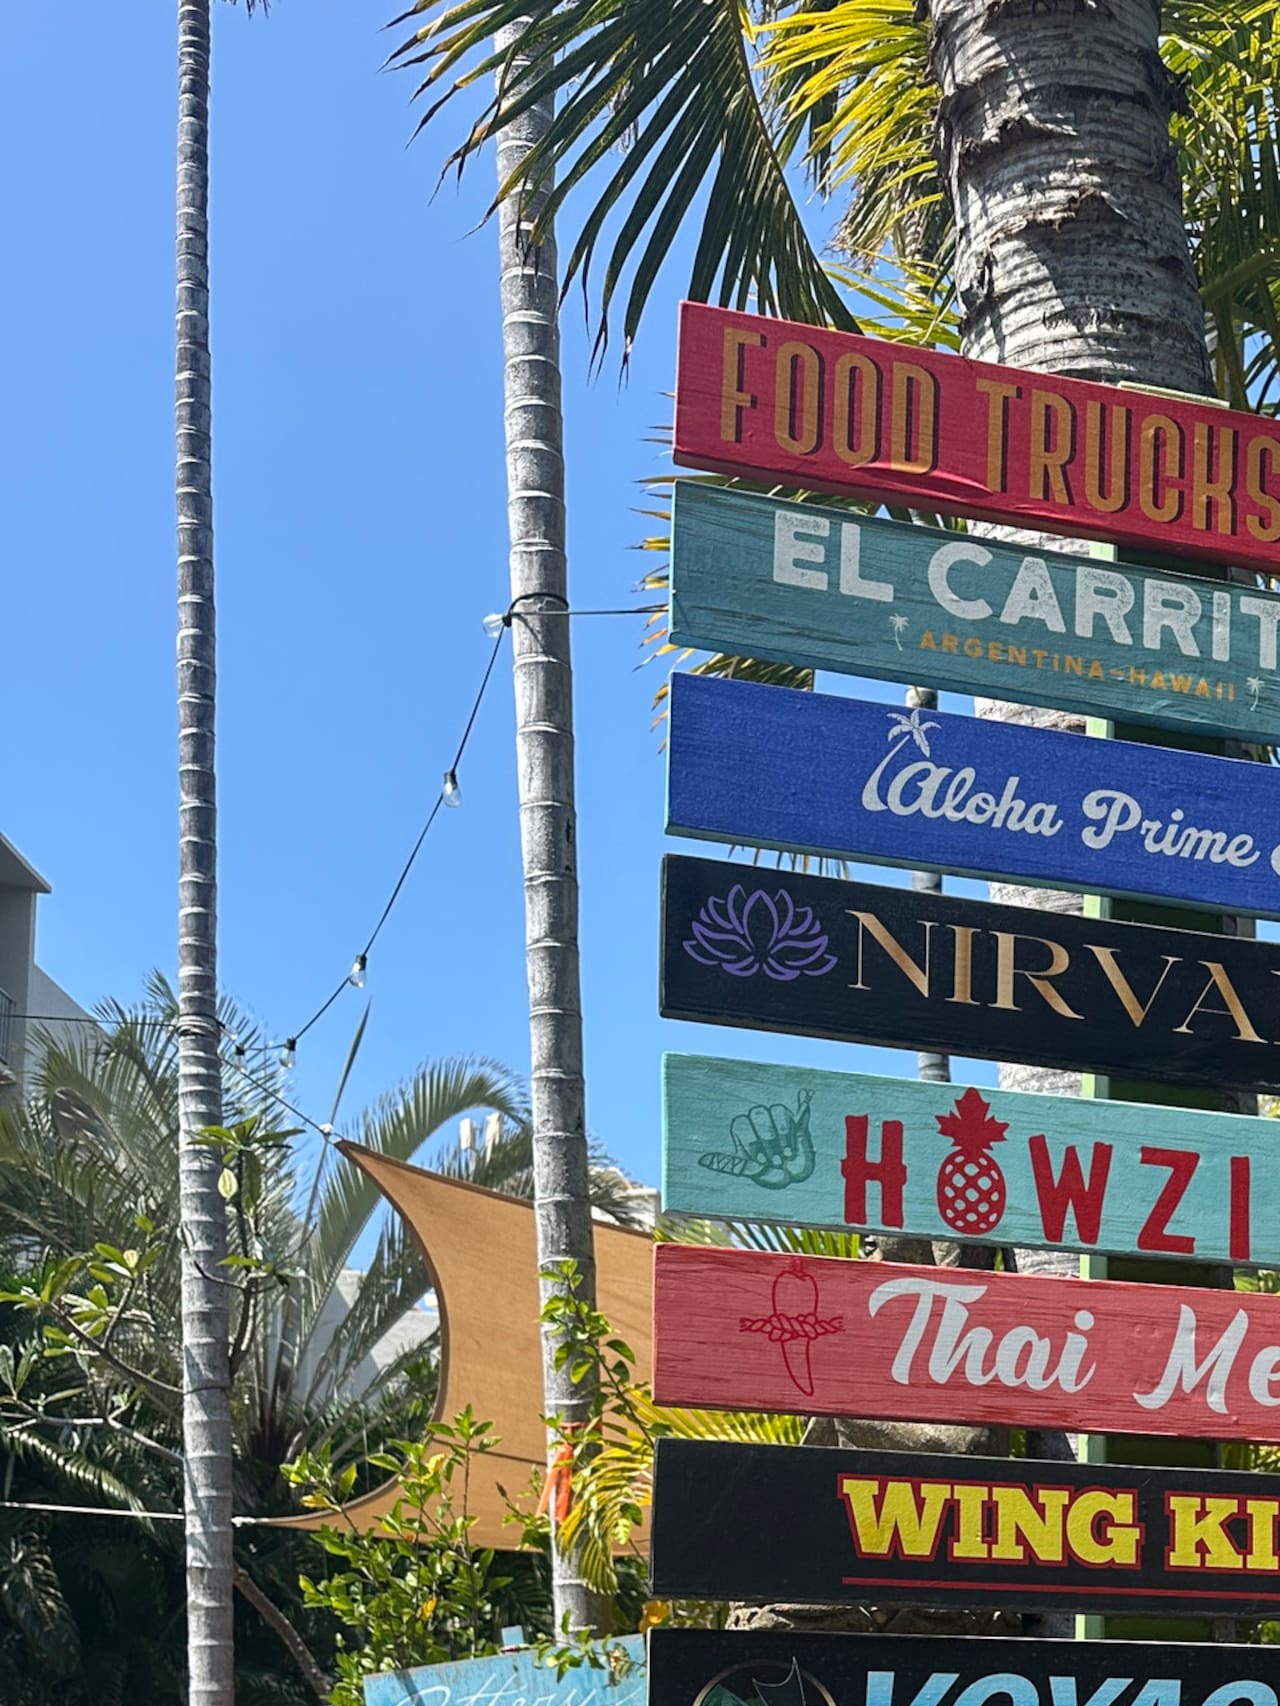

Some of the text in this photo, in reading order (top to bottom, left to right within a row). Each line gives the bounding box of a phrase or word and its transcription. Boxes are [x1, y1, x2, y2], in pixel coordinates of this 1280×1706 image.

[721, 327, 940, 475] FOOD
[772, 509, 896, 603] EL
[884, 759, 1064, 838] Aloha
[1082, 788, 1260, 868] Prime
[868, 1275, 1096, 1393] Thai
[837, 1472, 1142, 1570] WING
